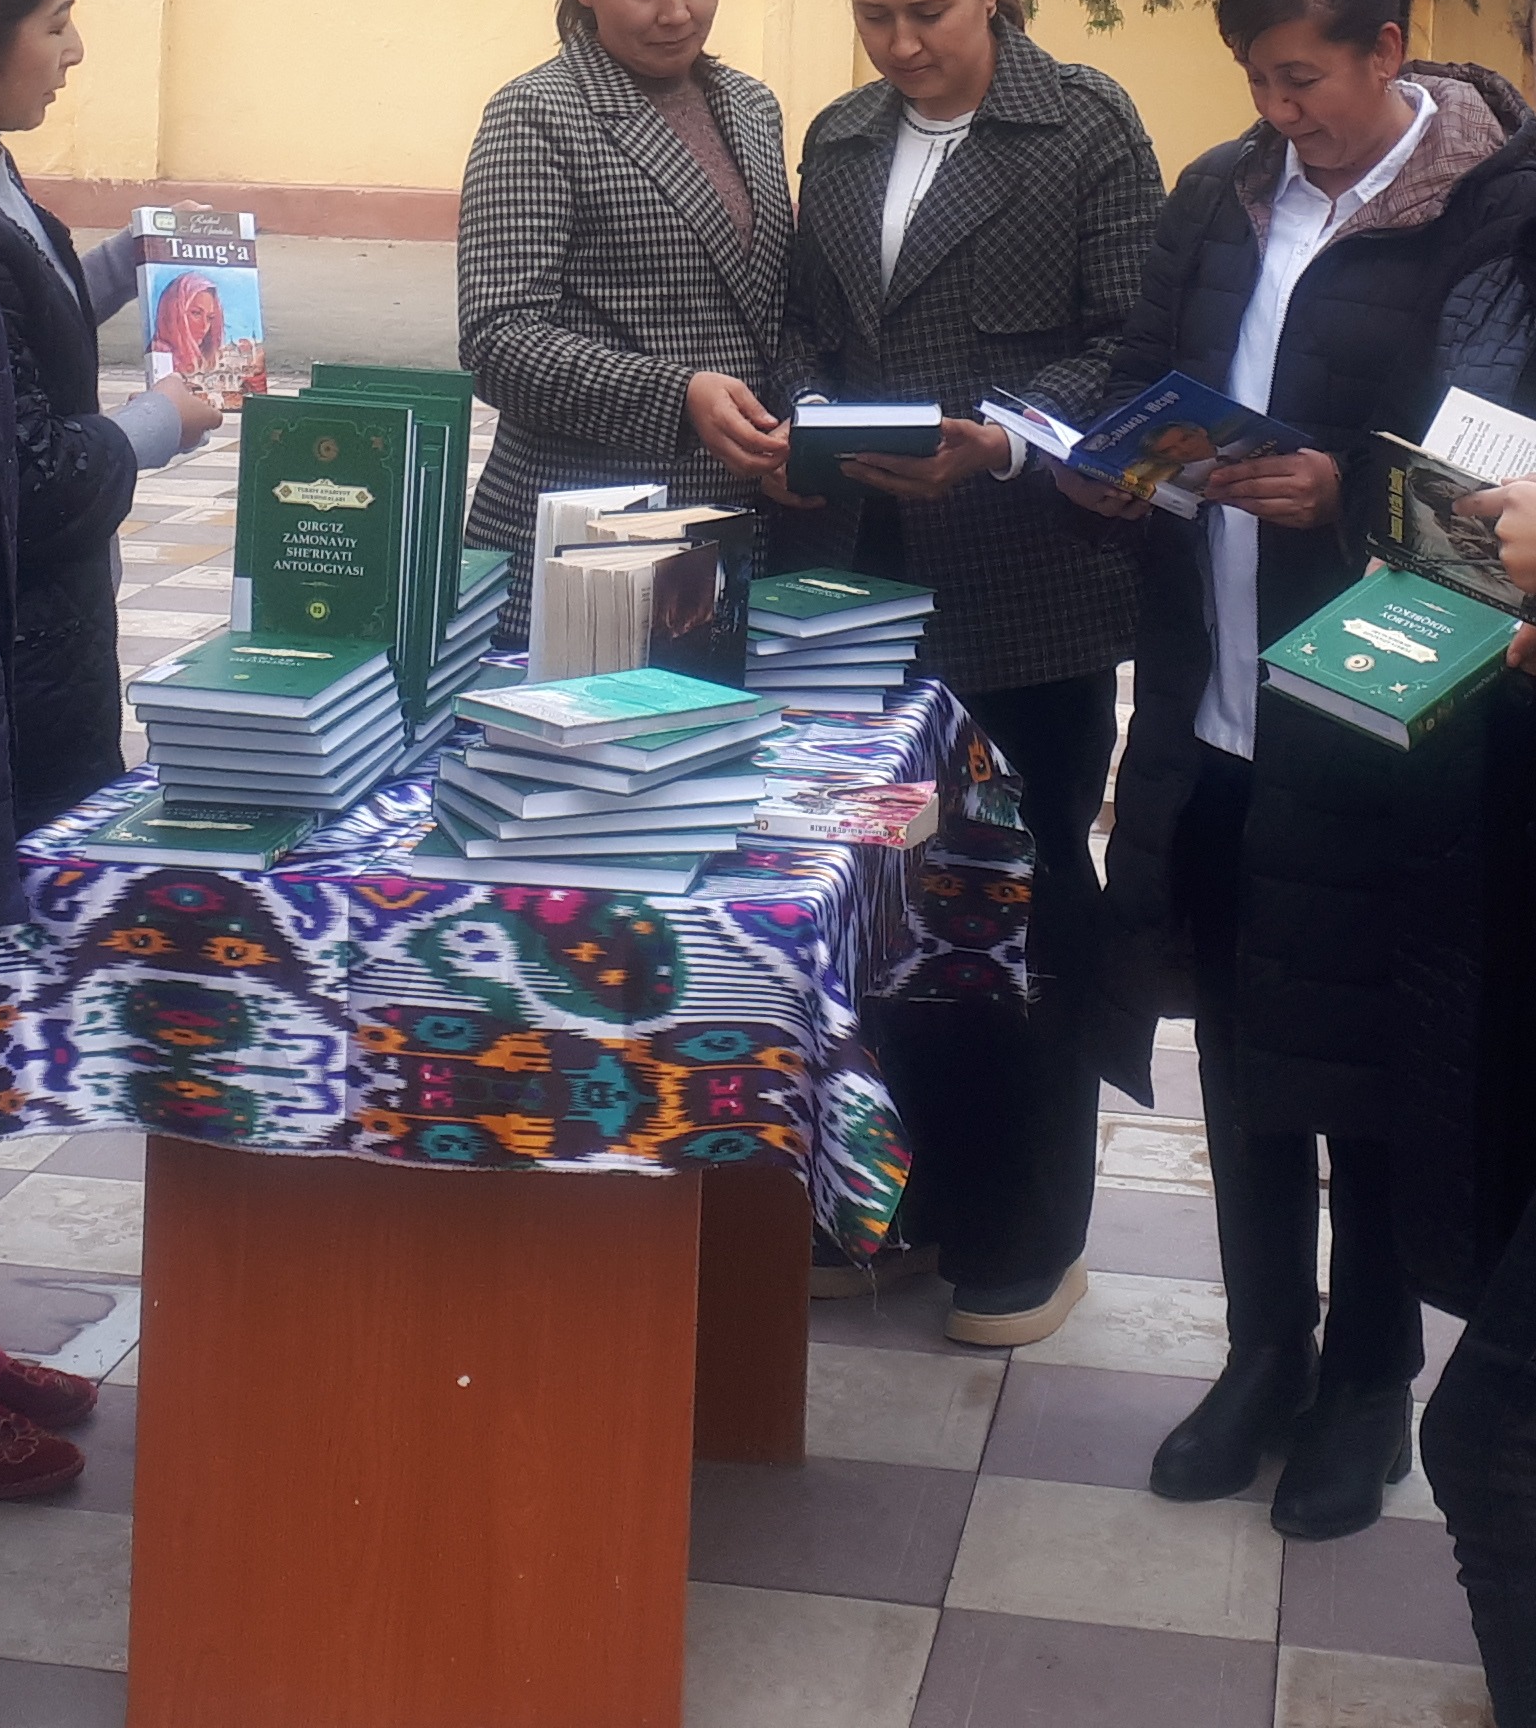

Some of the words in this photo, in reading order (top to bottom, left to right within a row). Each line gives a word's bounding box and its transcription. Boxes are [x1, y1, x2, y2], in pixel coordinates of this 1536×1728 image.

[166, 237, 250, 265] Tamg‘a
[282, 533, 358, 549] ZAMONAVIY
[273, 559, 364, 576] ANTOLOGIYASI
